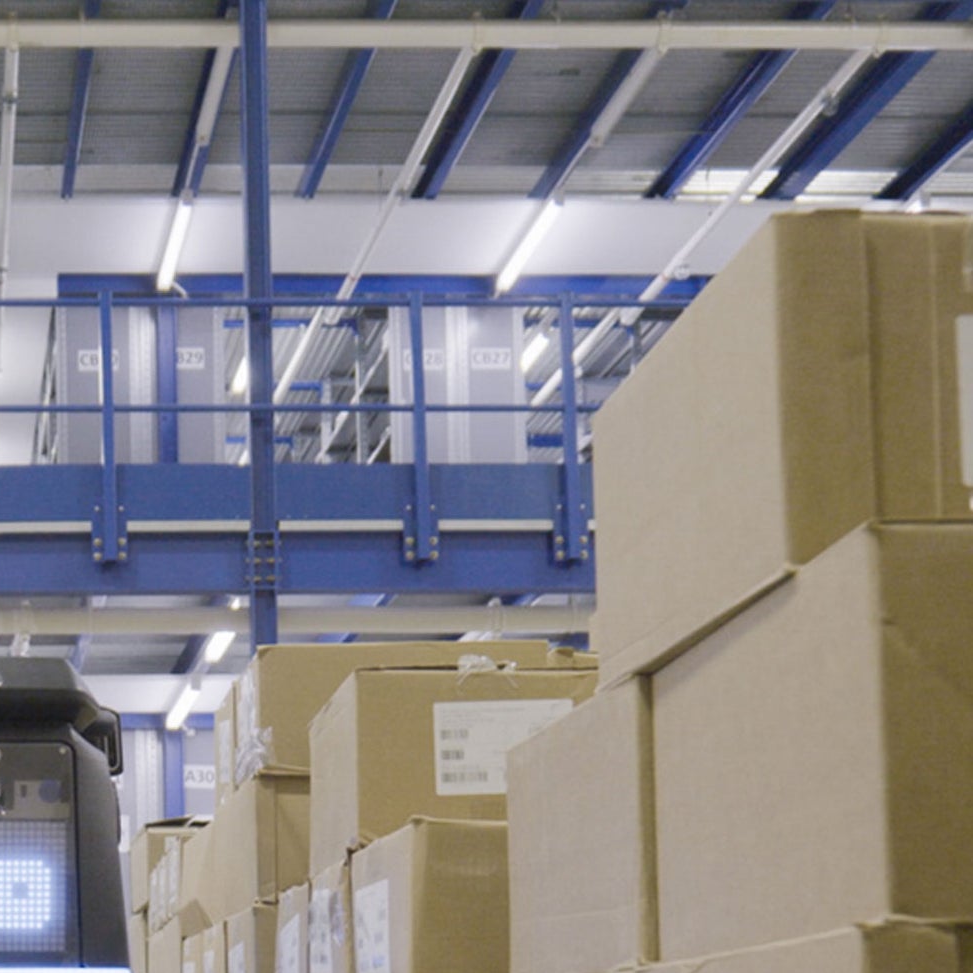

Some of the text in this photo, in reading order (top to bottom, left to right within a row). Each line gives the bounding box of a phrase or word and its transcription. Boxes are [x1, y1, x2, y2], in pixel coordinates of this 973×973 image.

[176, 350, 203, 364] B29
[405, 351, 444, 365] C28
[473, 351, 509, 365] CB27
[185, 769, 214, 784] A30
